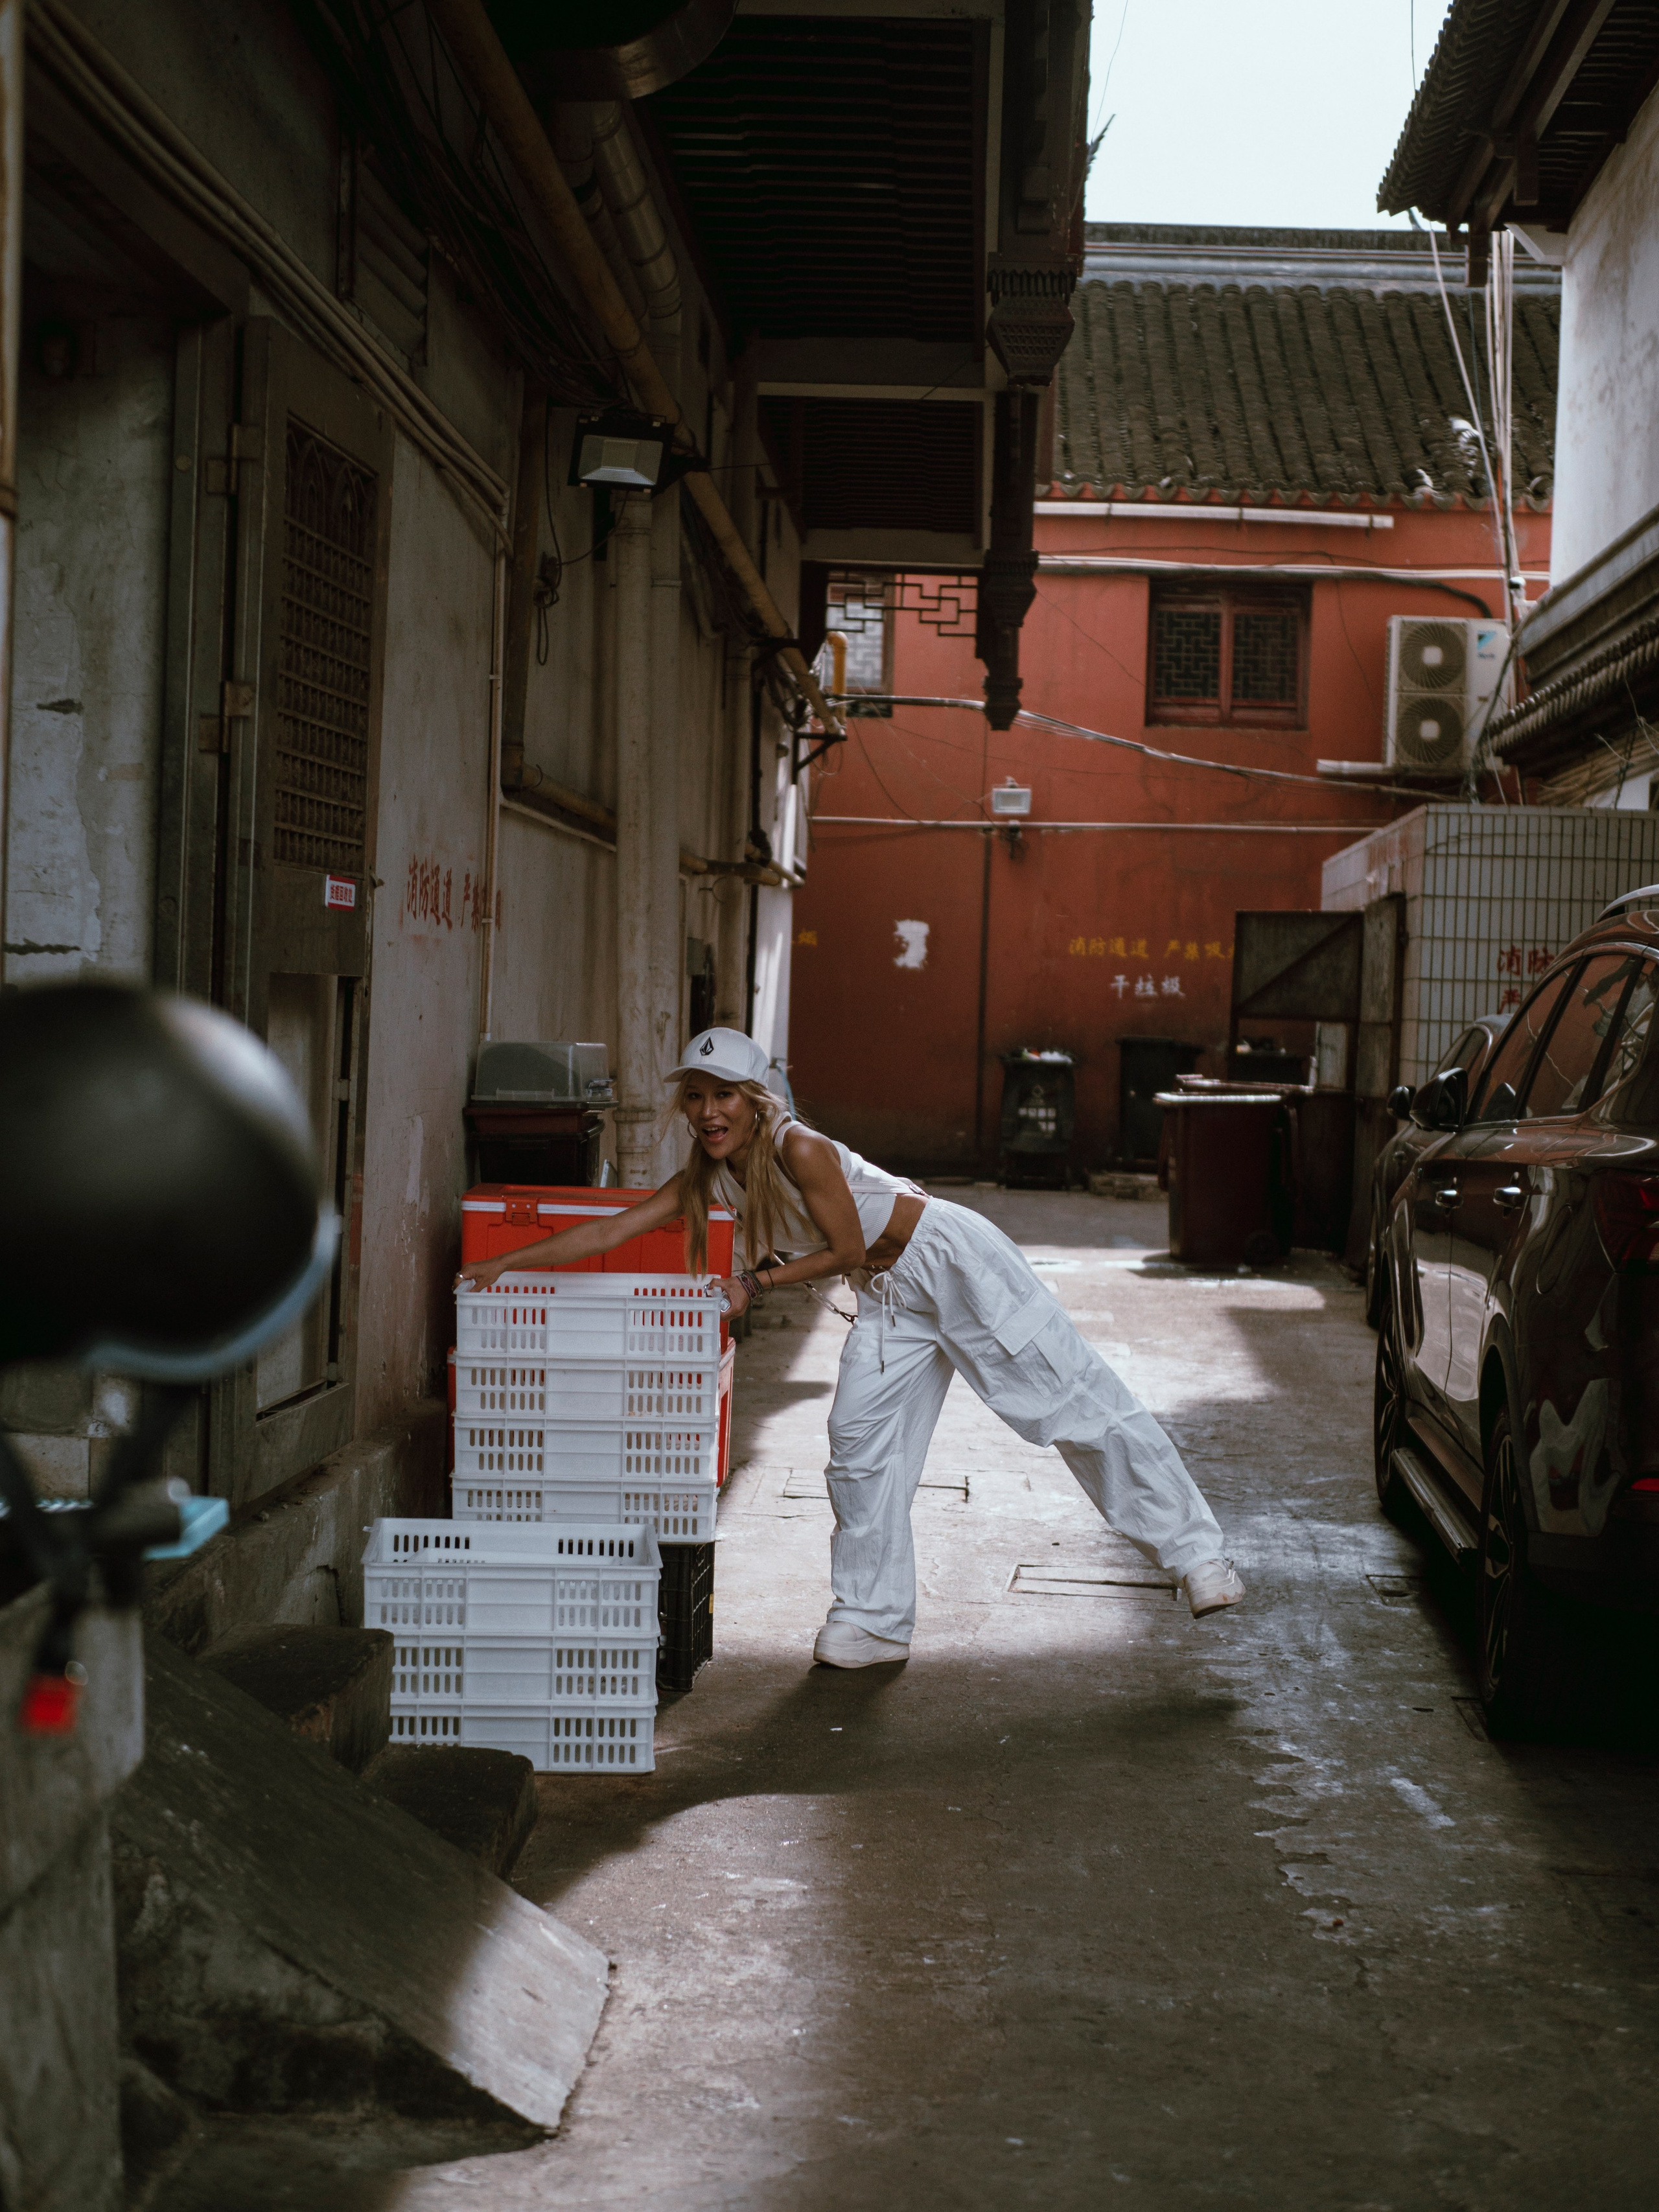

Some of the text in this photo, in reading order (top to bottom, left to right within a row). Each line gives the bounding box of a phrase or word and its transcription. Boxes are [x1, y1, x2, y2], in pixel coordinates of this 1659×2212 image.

[407, 853, 453, 931] 消防通道
[1069, 936, 1149, 959] 消防通道
